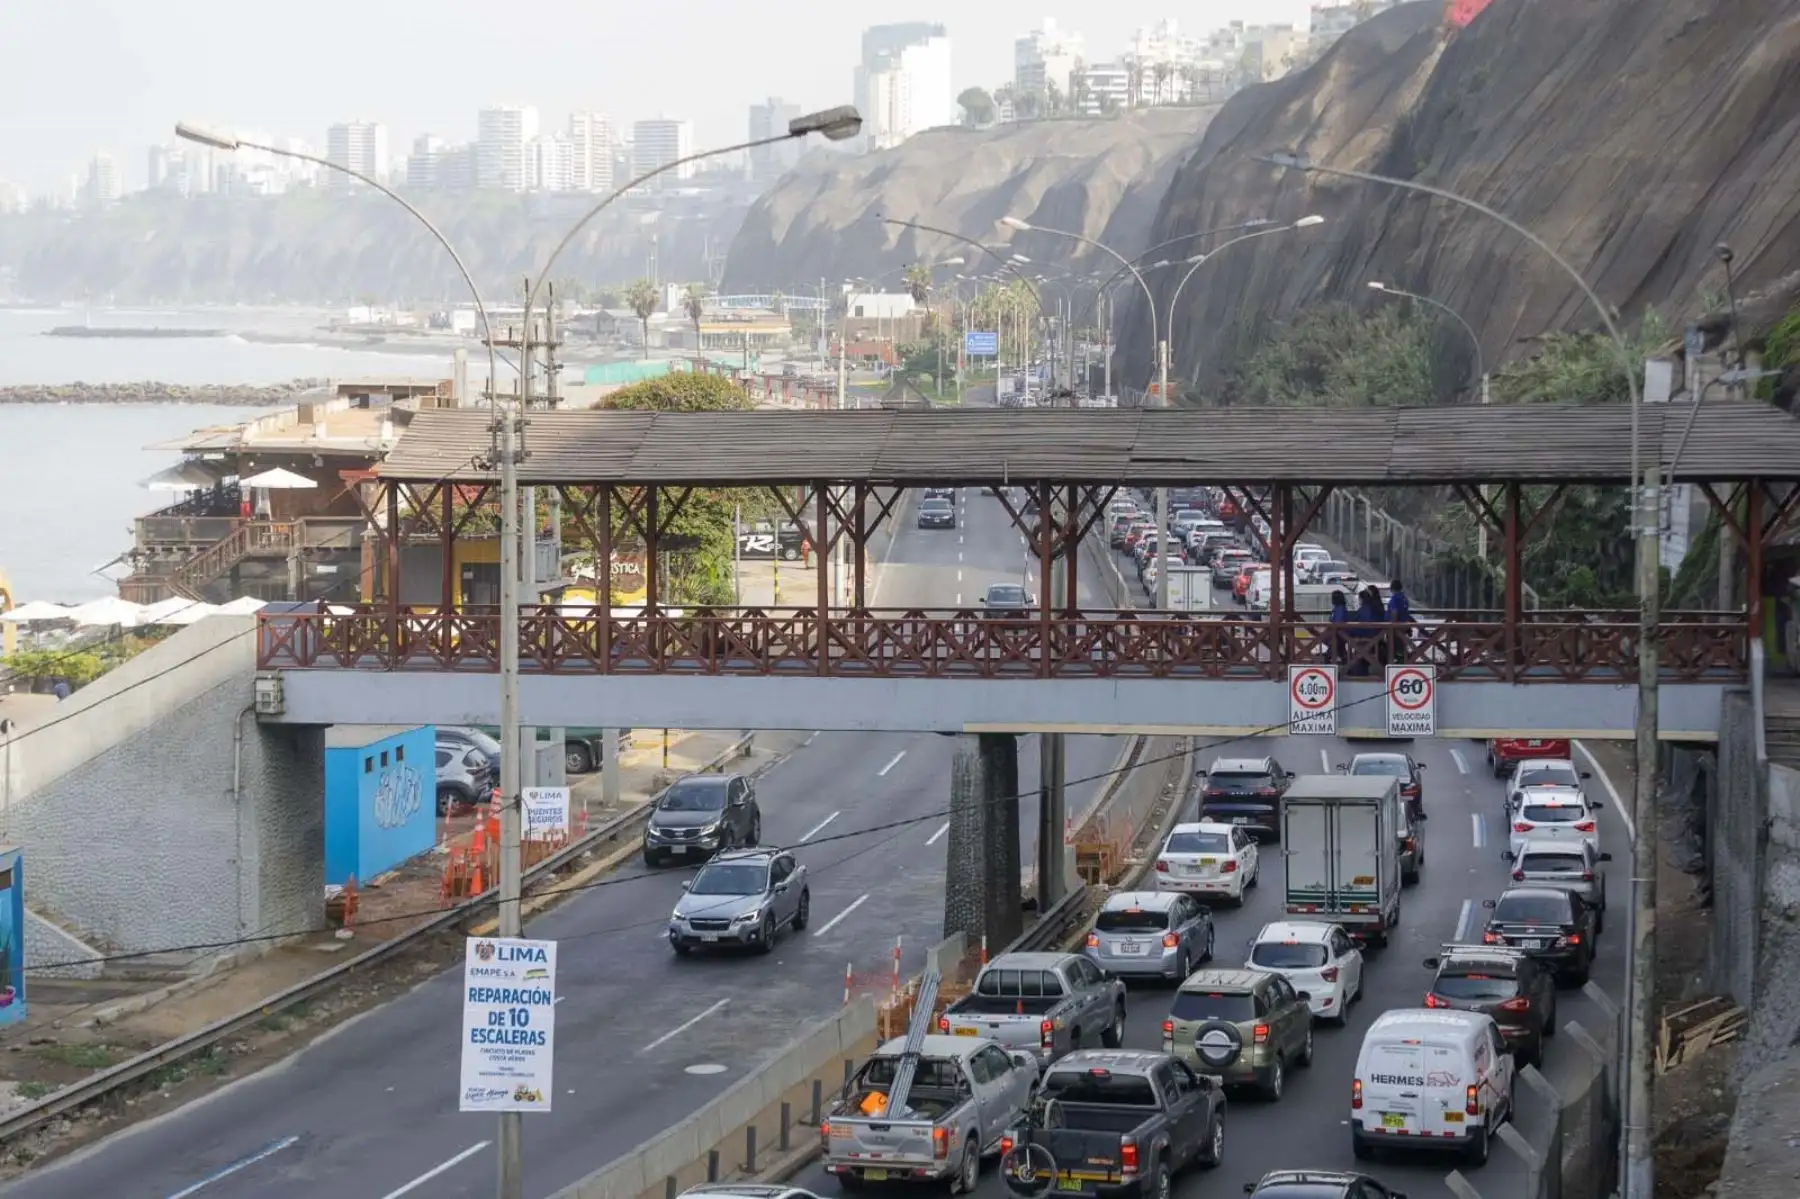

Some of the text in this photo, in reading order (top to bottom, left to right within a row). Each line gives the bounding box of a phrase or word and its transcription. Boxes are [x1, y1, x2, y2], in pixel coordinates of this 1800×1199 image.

[1298, 683, 1328, 695] 4.00m
[1399, 678, 1423, 695] 60
[1293, 711, 1333, 720] ALTURA
[1391, 712, 1431, 721] VELOCIDAD
[1292, 723, 1334, 733] MAXIMA
[1391, 723, 1432, 733] MAXIMA
[539, 792, 563, 800] LIMA
[498, 946, 548, 963] LIMA
[470, 967, 502, 977] EMAPE
[468, 987, 551, 1005] REPARACIÓN
[488, 1008, 530, 1028] DE 10
[471, 1027, 546, 1046] ESCALERAS
[1371, 1073, 1424, 1086] HERMES
